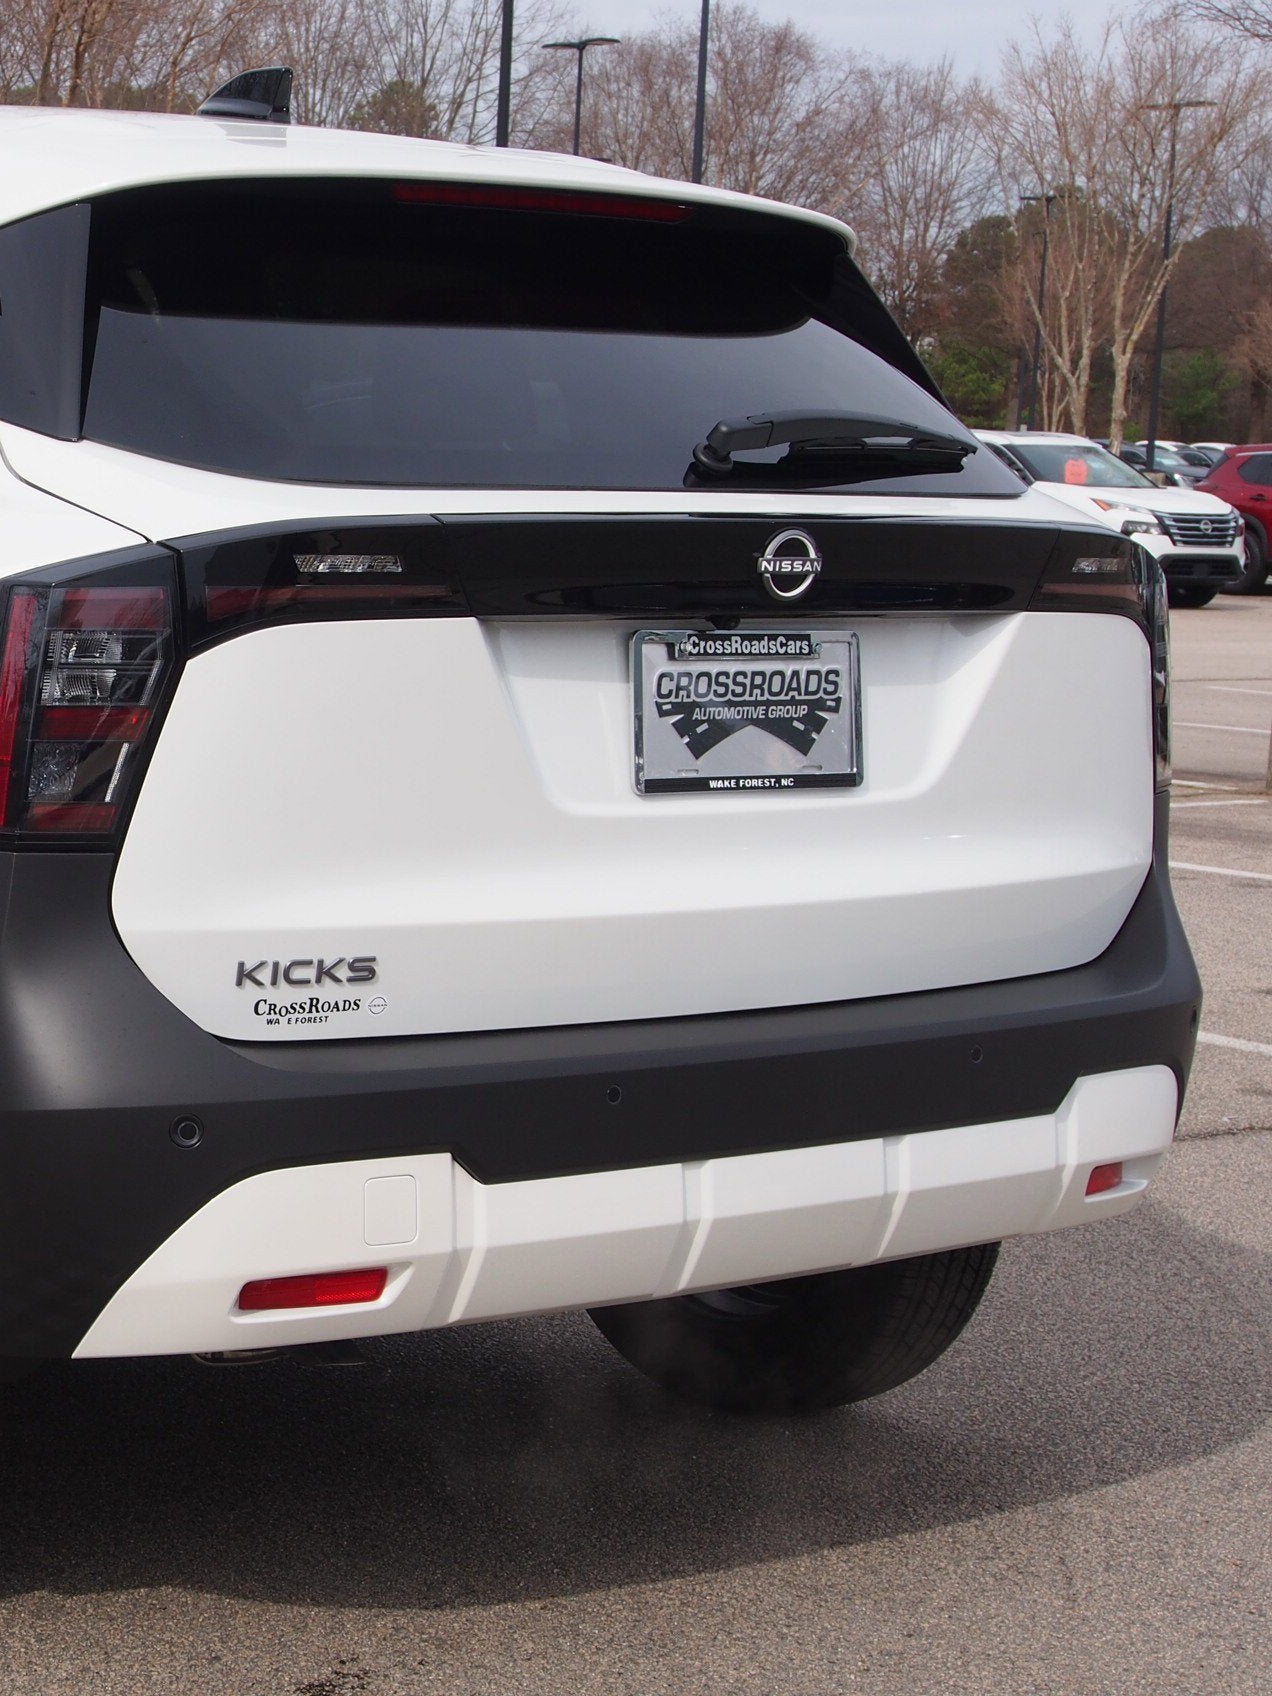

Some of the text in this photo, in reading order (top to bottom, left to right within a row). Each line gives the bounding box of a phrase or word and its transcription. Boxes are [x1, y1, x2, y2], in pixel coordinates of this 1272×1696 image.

[760, 560, 822, 572] NISSAN
[690, 635, 810, 655] CrossRoadsCars
[656, 668, 840, 700] CROSSROADS
[692, 704, 809, 721] AUTOMOTIVE GROUP
[709, 777, 795, 789] WAKE FOREST, NC
[235, 955, 377, 987] KICKS
[294, 1015, 330, 1025] FOREST
